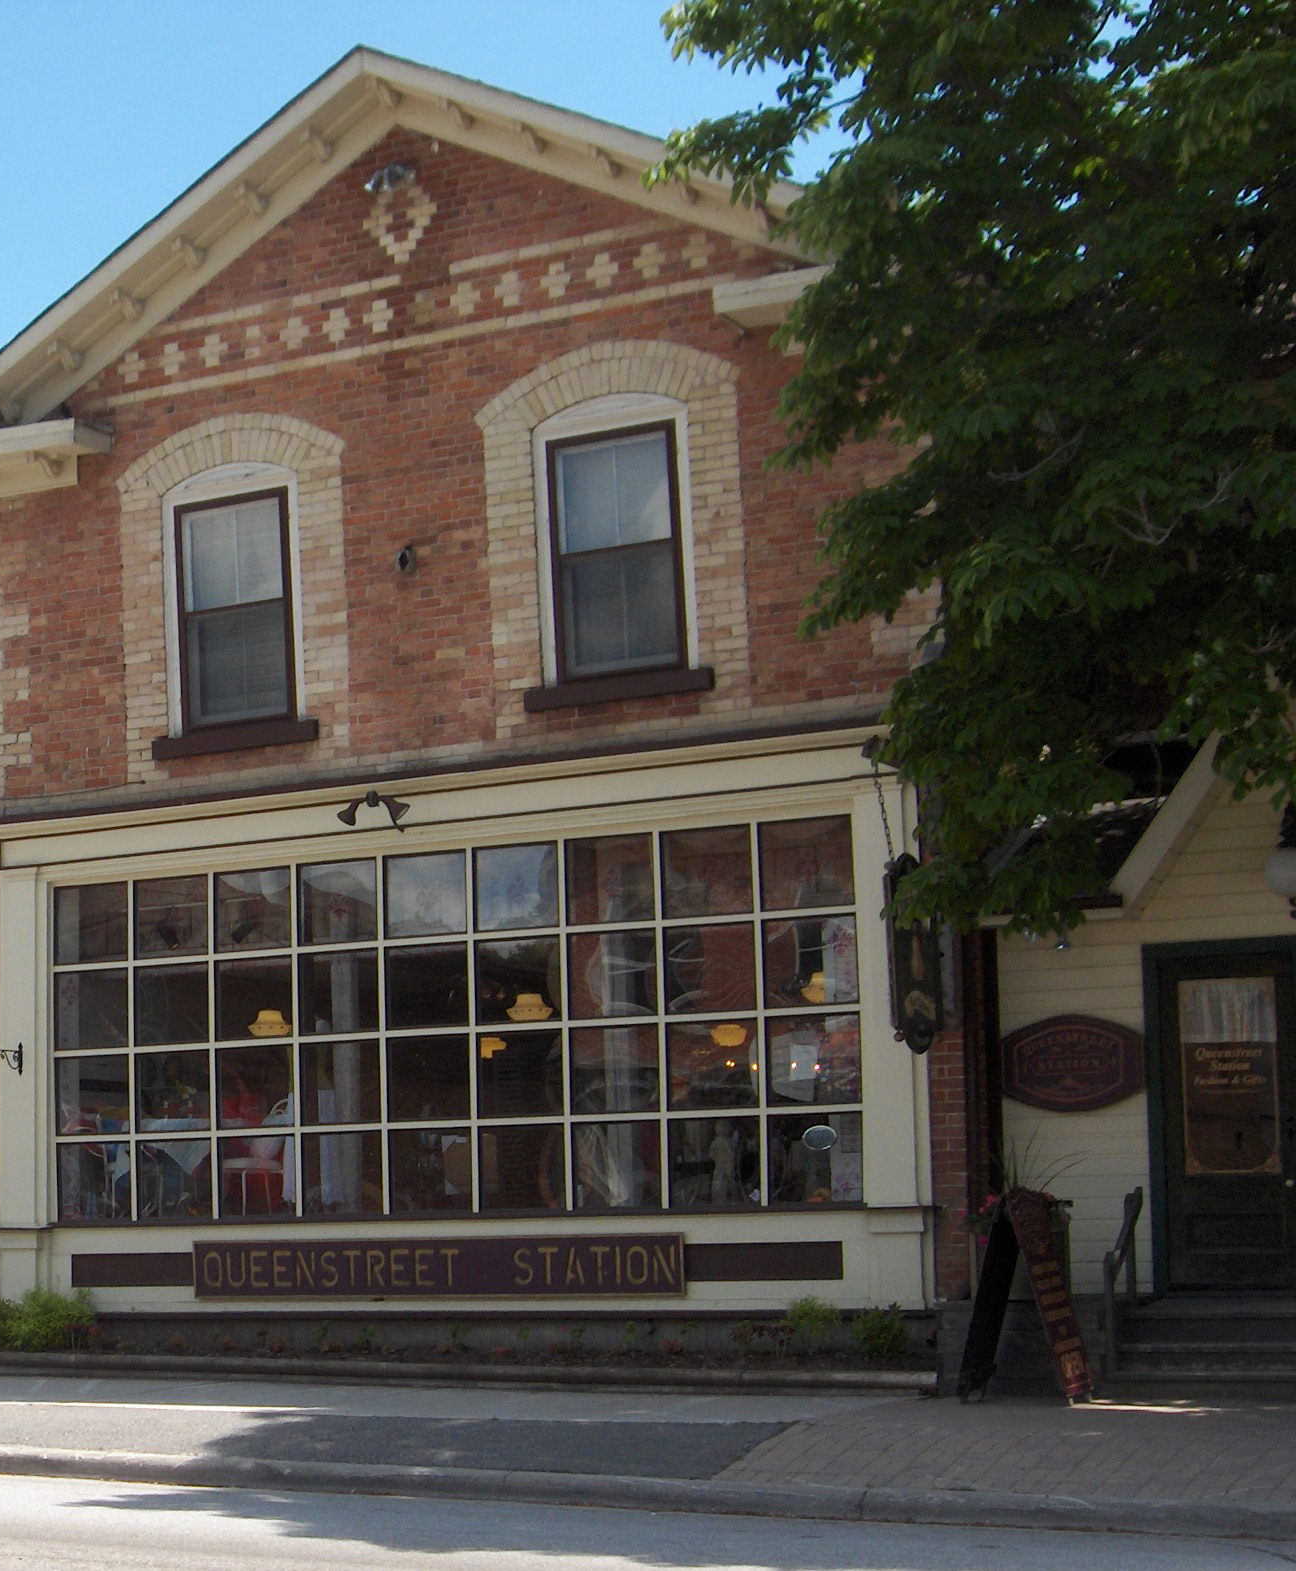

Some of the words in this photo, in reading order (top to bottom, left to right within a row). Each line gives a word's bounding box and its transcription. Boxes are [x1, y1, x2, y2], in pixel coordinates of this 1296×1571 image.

[1195, 1047, 1263, 1061] Queenstreet
[1209, 1060, 1251, 1071] Station
[1193, 1075, 1229, 1085] Fashion
[1231, 1075, 1240, 1085] &
[1243, 1074, 1267, 1085] Gifts
[203, 1247, 459, 1289] QUEENSTREET
[513, 1244, 677, 1286] STATION
